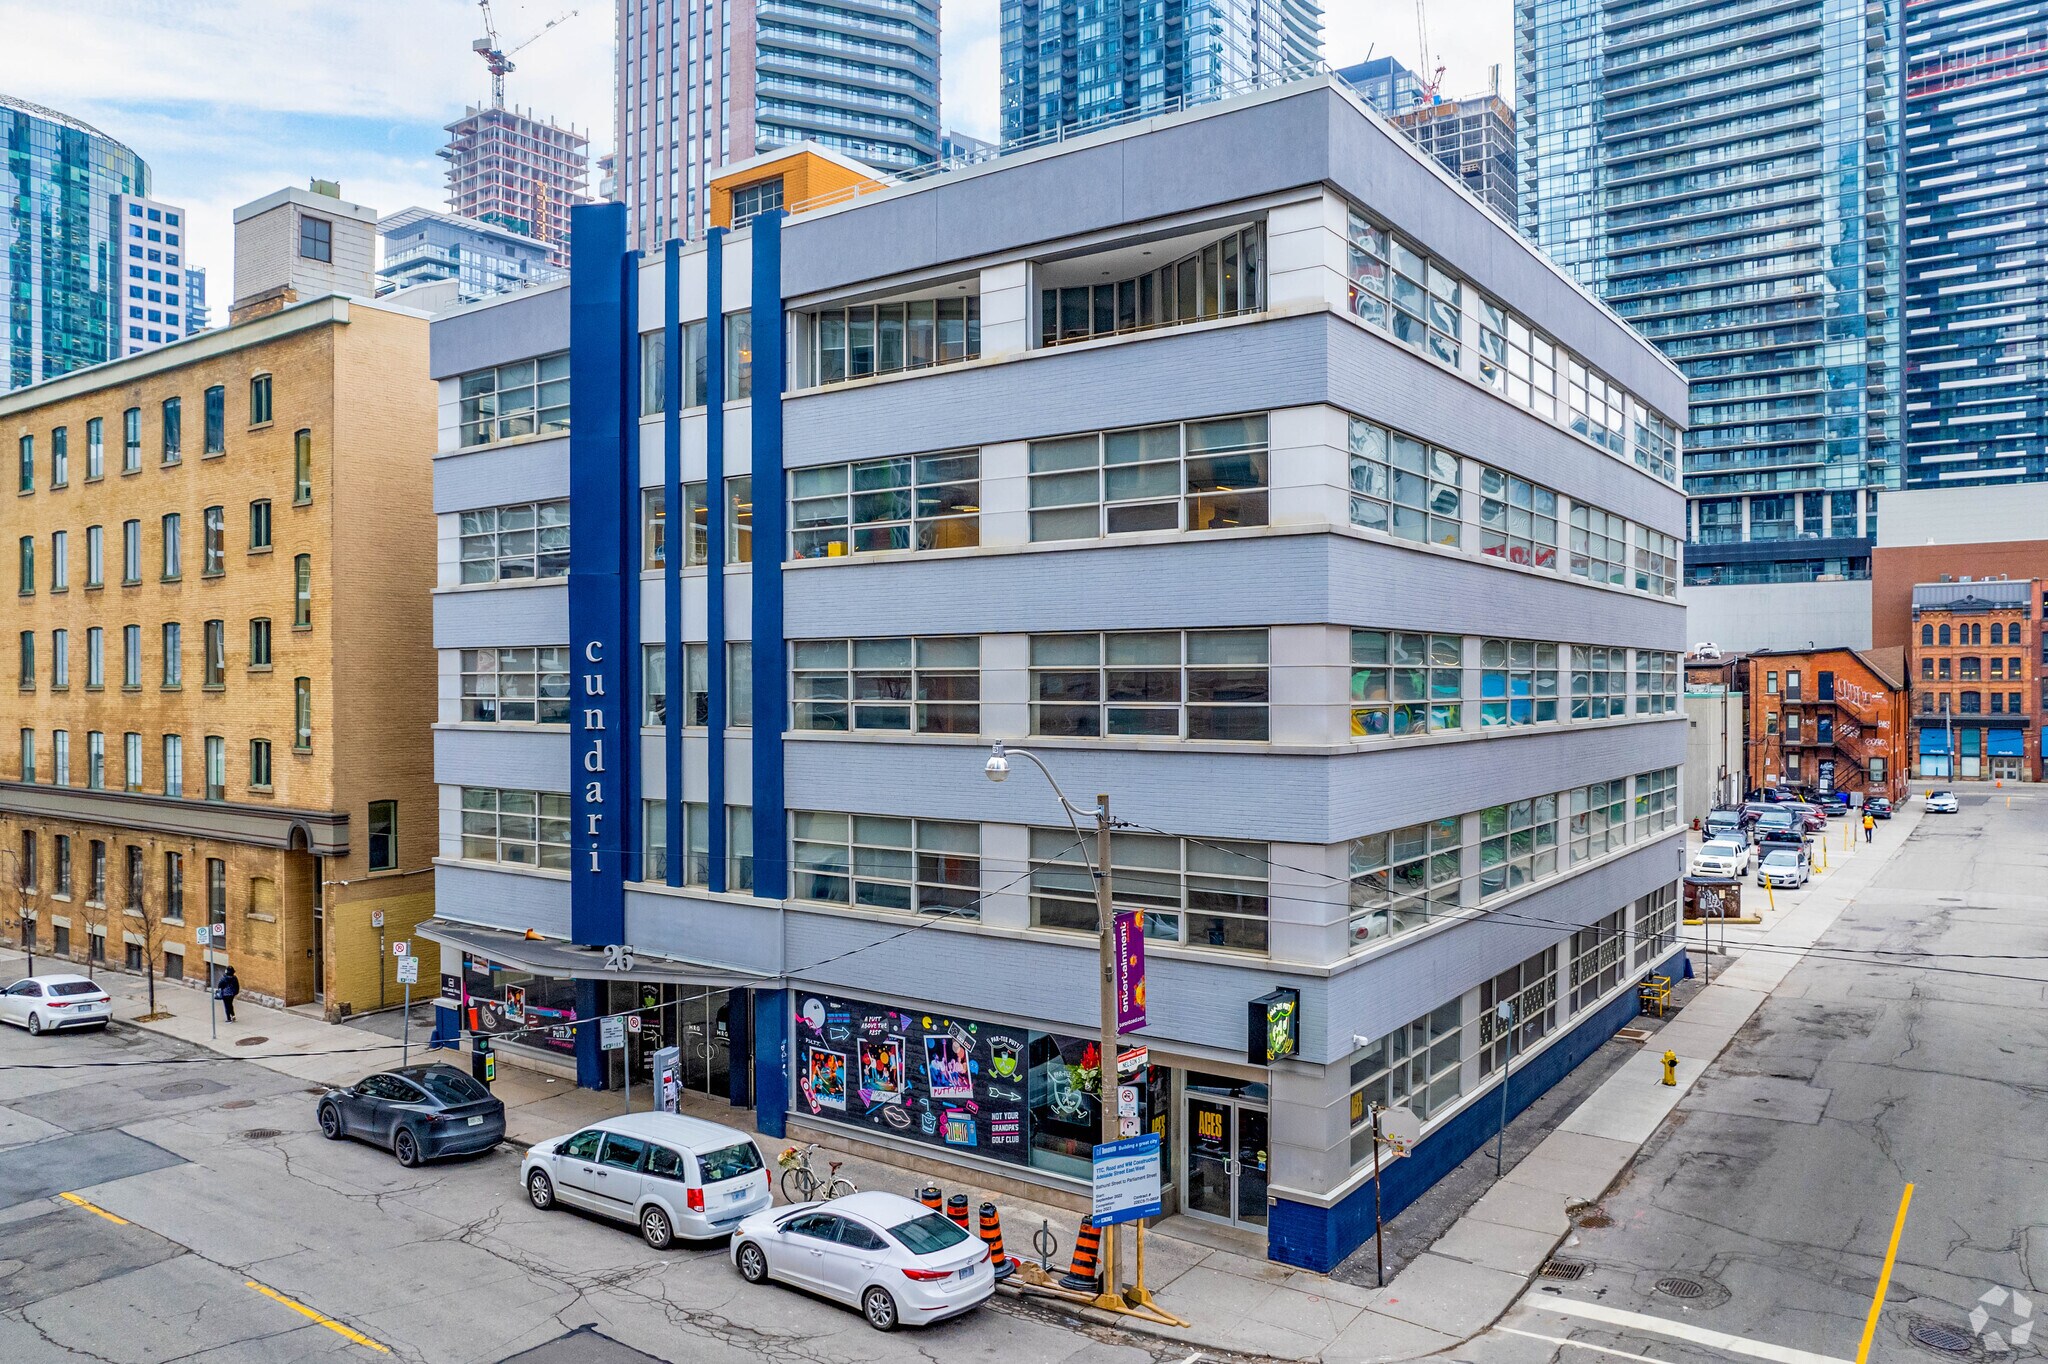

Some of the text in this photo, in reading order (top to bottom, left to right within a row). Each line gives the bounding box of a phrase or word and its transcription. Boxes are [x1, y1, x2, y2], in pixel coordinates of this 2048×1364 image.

[583, 640, 606, 872] cundari
[604, 944, 635, 973] 26
[1120, 921, 1129, 1013] entertainment
[990, 1035, 1020, 1049] PAR-TEE PUTT
[1122, 1059, 1137, 1068] NELSON
[933, 1087, 951, 1096] PUTT
[991, 1111, 1019, 1120] NOT YOUR
[991, 1124, 1019, 1132] GRANDPA'S
[1199, 1110, 1222, 1137] ACES
[991, 1135, 1020, 1144] GOLF CLUB
[1118, 1143, 1135, 1151] Building
[1133, 1156, 1158, 1166] Construction
[1096, 1172, 1113, 1180] Adelaide
[1096, 1181, 1111, 1190] Bathurst
[1126, 1174, 1146, 1183] Parliament
[1096, 1195, 1114, 1204] September
